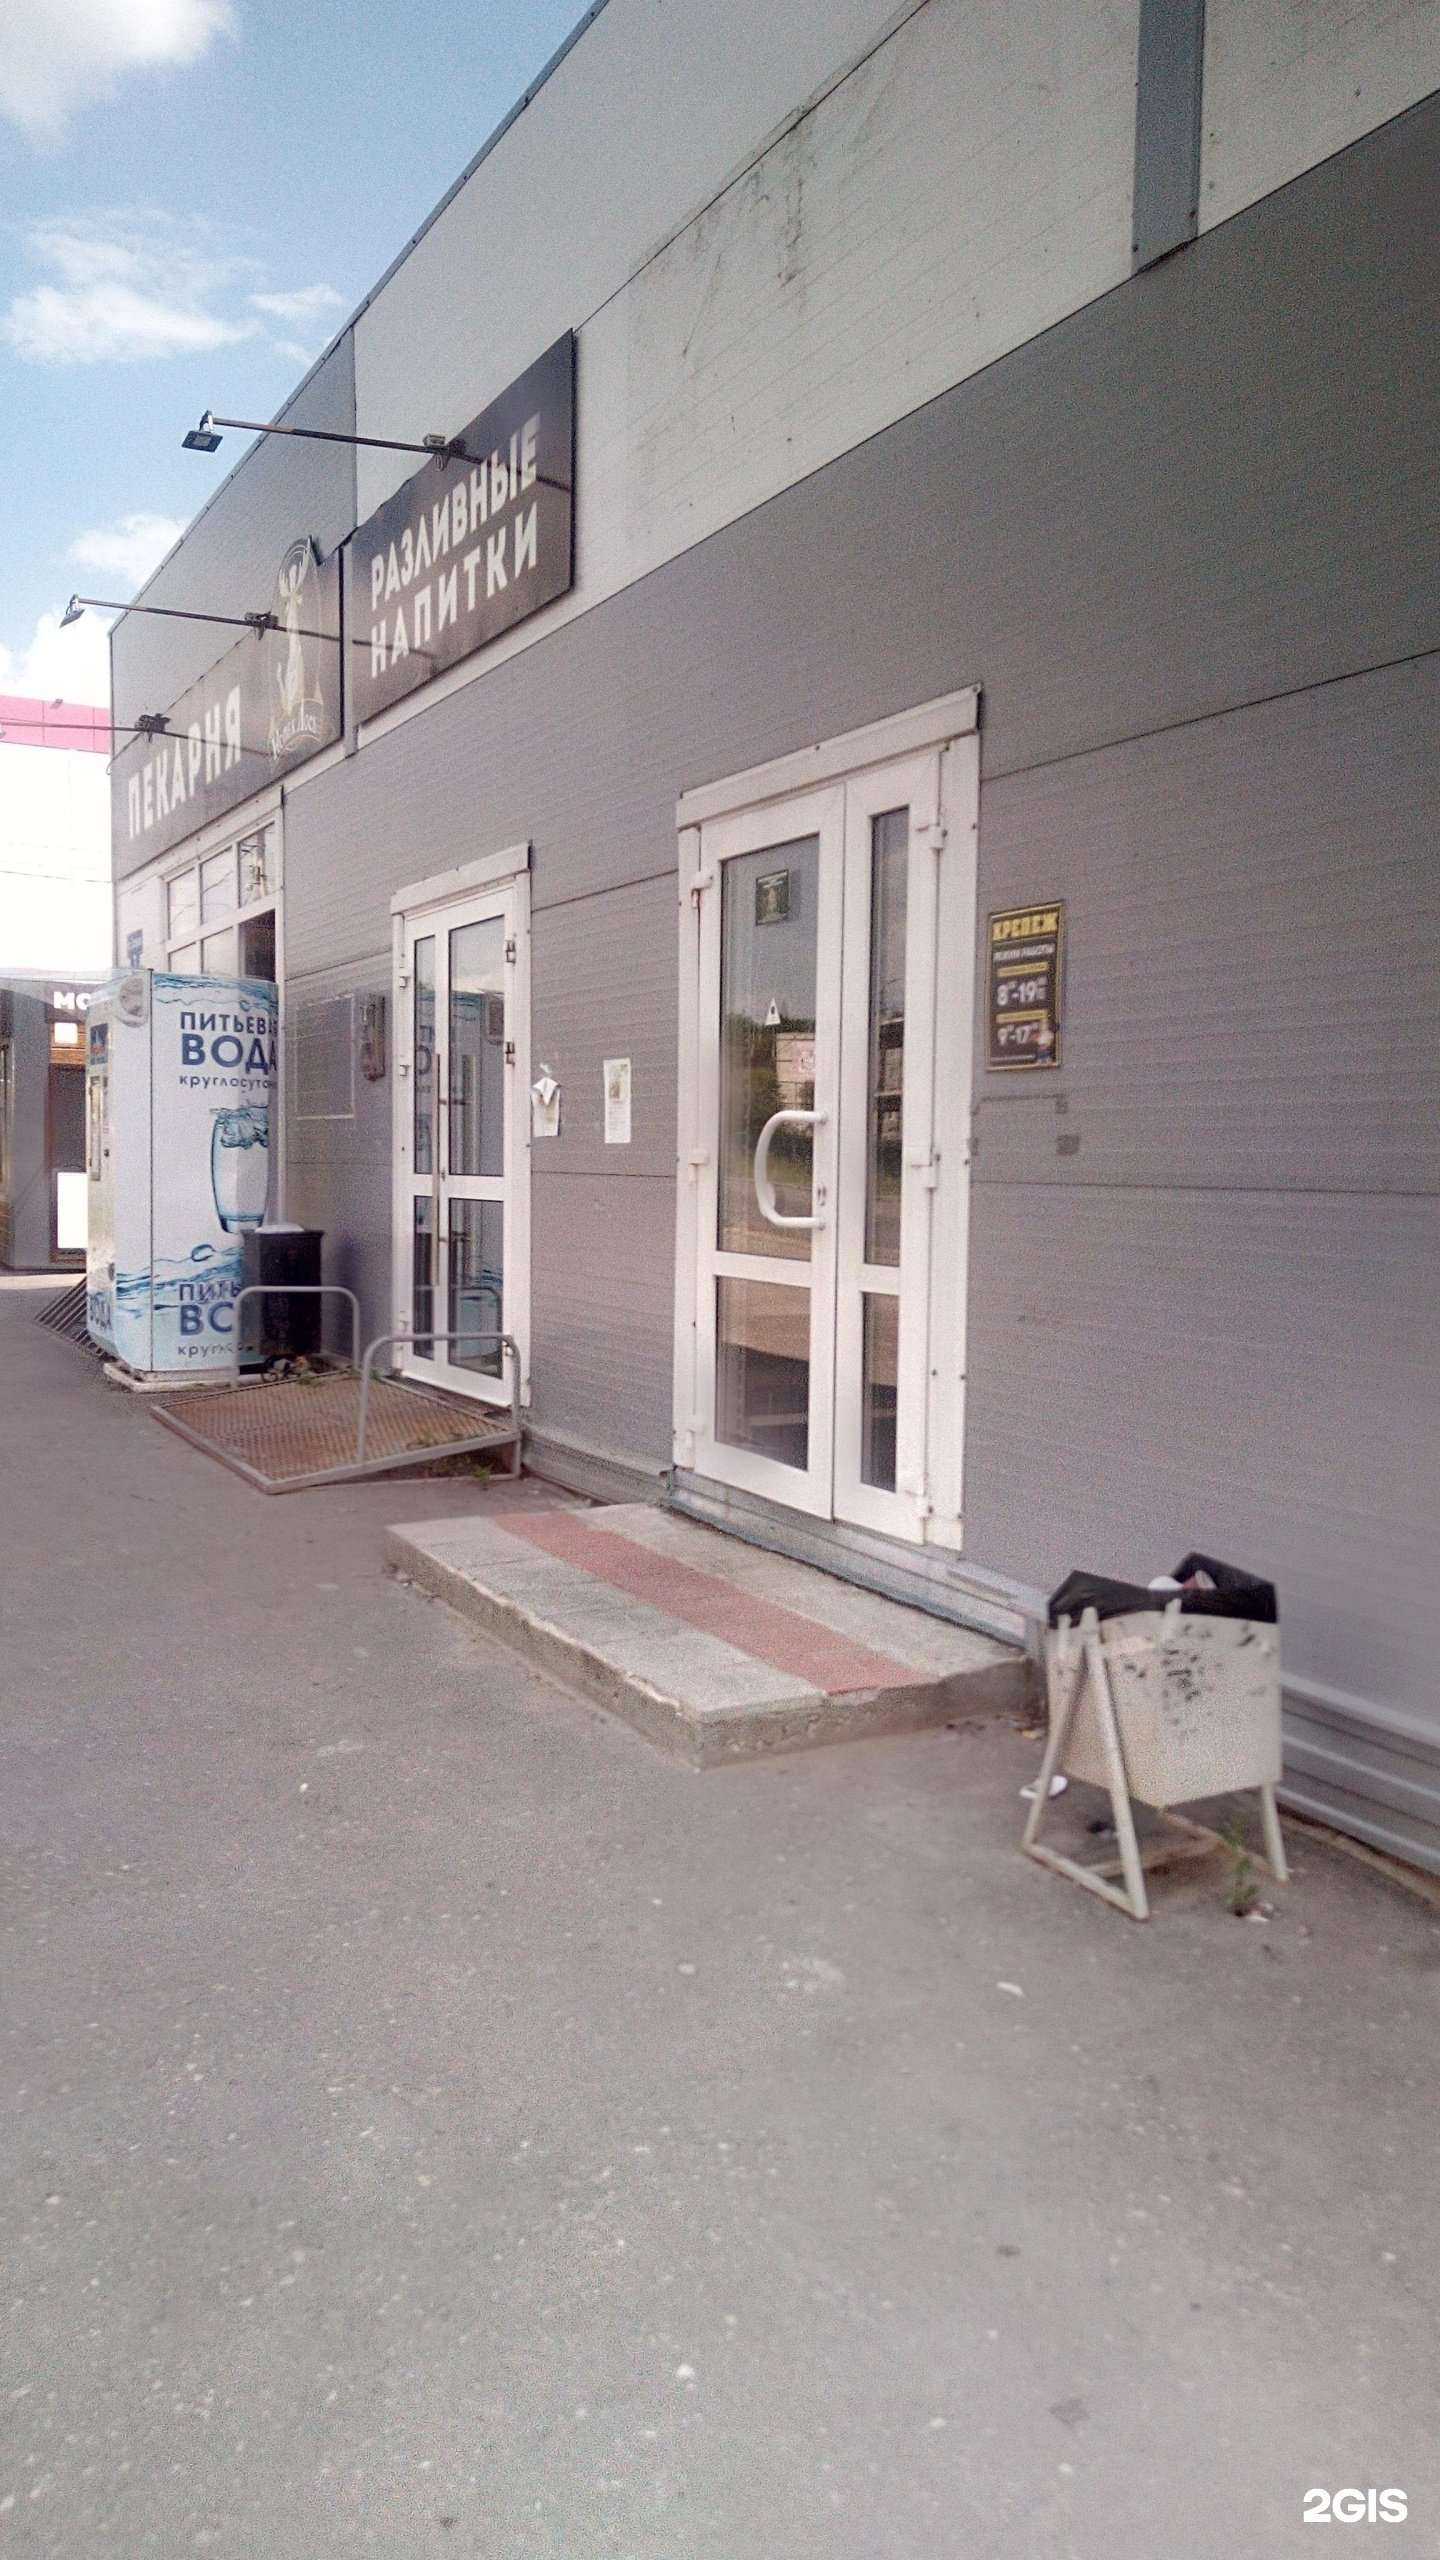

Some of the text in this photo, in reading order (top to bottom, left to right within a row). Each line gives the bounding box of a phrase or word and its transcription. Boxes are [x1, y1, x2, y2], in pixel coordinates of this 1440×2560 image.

[371, 411, 542, 612] РАЗЛИВНЫЕ
[371, 501, 538, 678] НАПИТКИ
[128, 684, 241, 839] ПЕКАРНЯ
[992, 912, 1058, 941] КРЕПЕЖ
[179, 1280, 241, 1301] ПИТЬ
